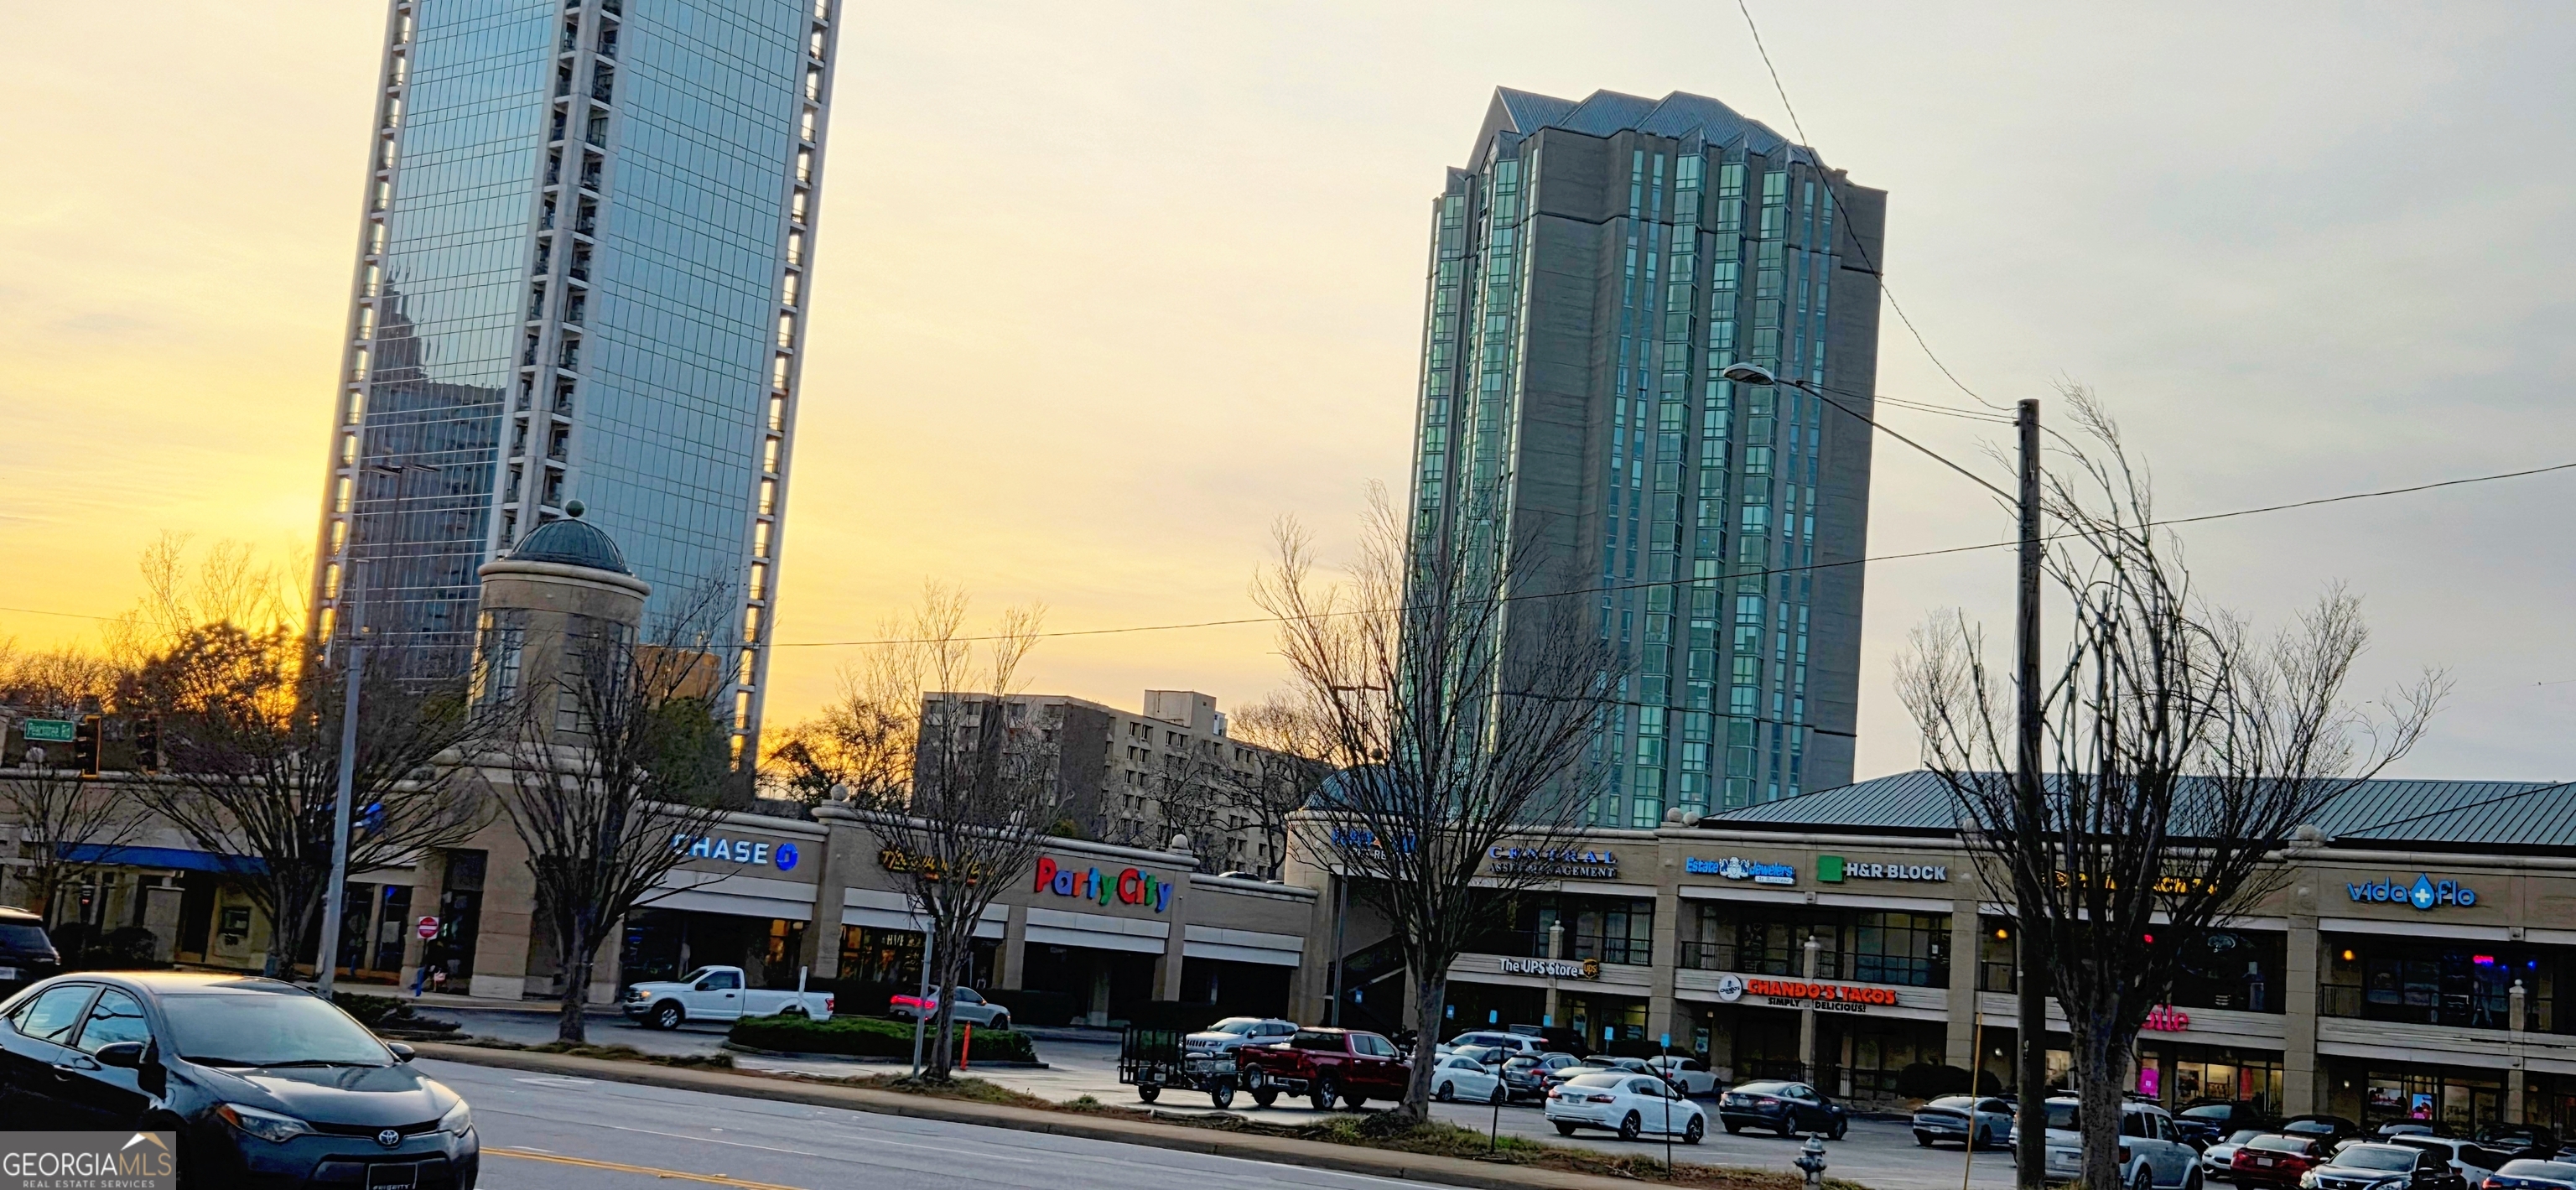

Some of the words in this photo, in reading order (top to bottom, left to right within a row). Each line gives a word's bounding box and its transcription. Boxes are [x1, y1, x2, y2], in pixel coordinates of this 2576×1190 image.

[61, 724, 70, 739] Rd
[673, 834, 770, 865] CHASE
[1489, 846, 1618, 865] CENTRAL
[1685, 856, 1719, 874] Estate
[1748, 860, 1794, 877] Jewelers
[1846, 862, 1883, 878] H&R
[1887, 864, 1947, 881] BLOCK
[2346, 876, 2408, 903] vida
[2437, 879, 2476, 907] flo
[1499, 958, 1519, 971] The
[1522, 959, 1545, 974] UPS
[1547, 962, 1578, 977] Store
[1748, 979, 1837, 1000] CHANDO'S
[1840, 986, 1897, 1006] TACOS
[1768, 997, 1800, 1007] SIMPLY
[1814, 1000, 1867, 1013] DELICIOUS!
